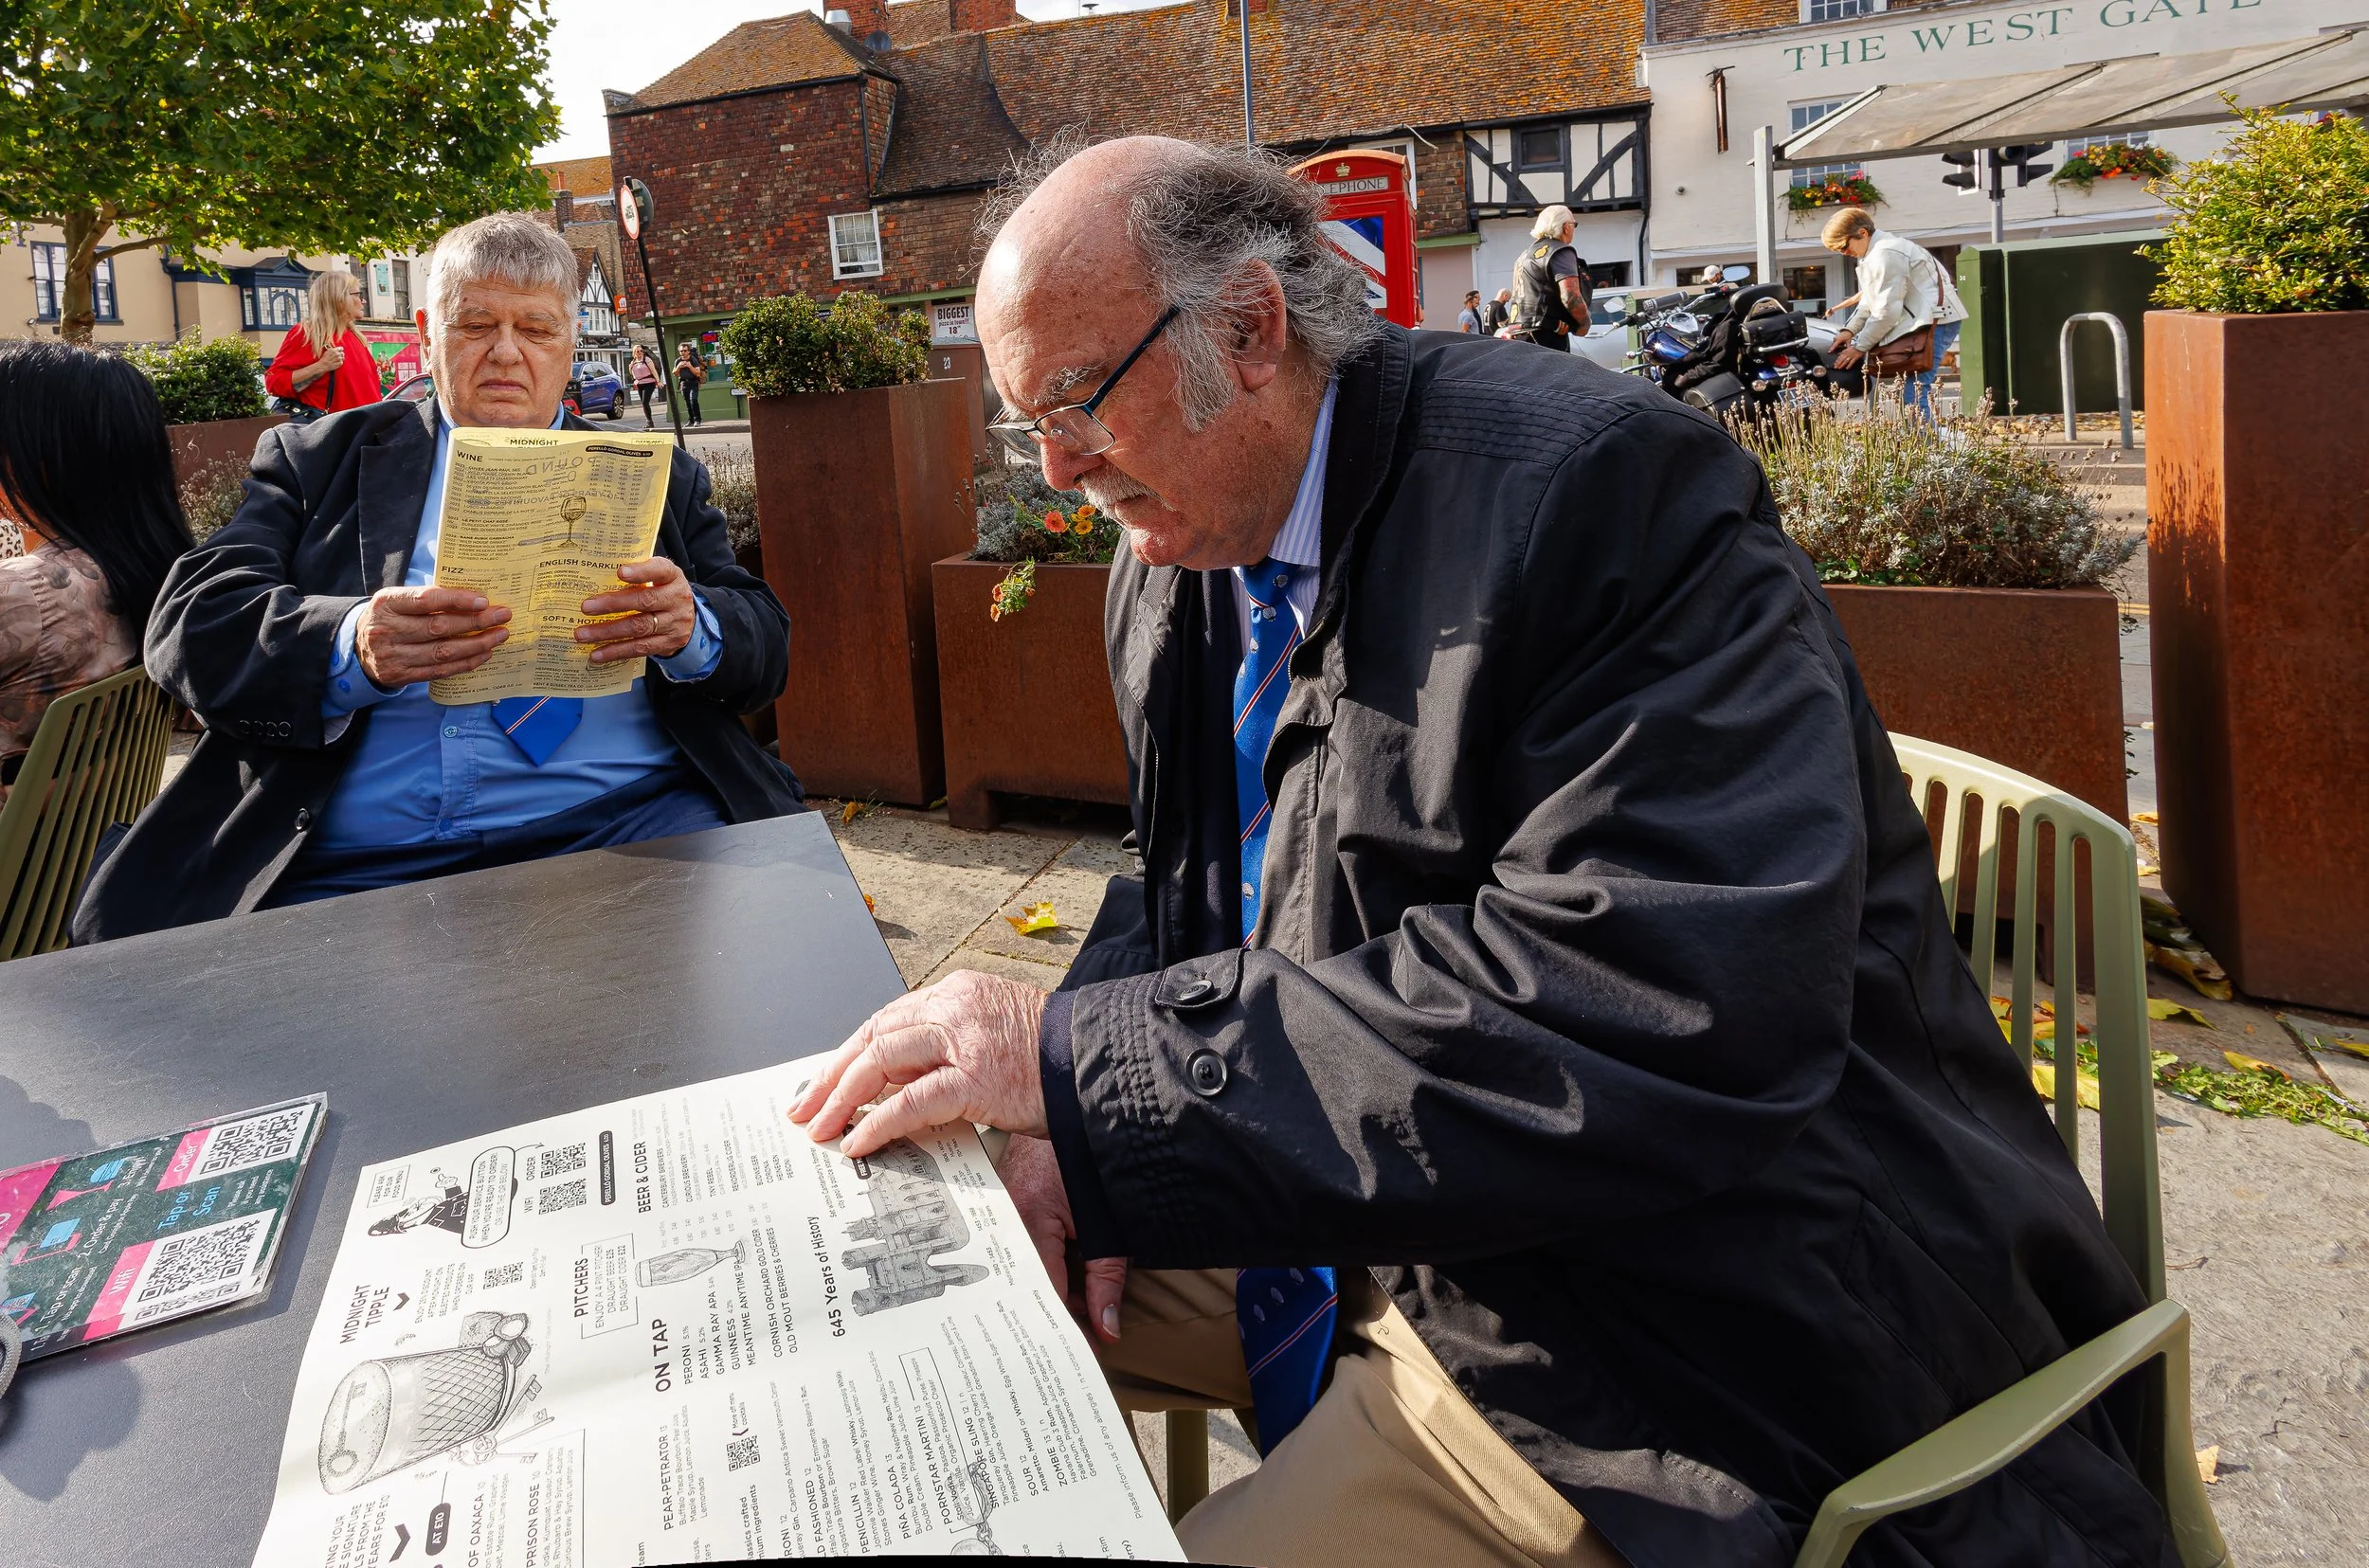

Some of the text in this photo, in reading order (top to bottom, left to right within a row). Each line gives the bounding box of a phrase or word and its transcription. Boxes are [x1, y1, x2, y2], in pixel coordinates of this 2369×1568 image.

[1782, 34, 1887, 72] THE
[1911, 8, 2073, 54] WEST
[938, 306, 969, 319] BIGGEST
[943, 356, 951, 369] 23
[457, 450, 483, 462] WINE
[539, 558, 579, 568] ENGLISH
[173, 1145, 197, 1172] Order
[477, 1161, 486, 1183] BUTTON
[526, 1156, 535, 1181] ORDER
[634, 1142, 648, 1174] CIDER
[858, 1163, 867, 1176] FREE
[657, 1148, 669, 1208] CANTERBURY BREWERS
[680, 1155, 693, 1202] CURIOUS BREWERY
[706, 1167, 714, 1184] REBEL
[192, 1186, 221, 1216] Scan
[226, 1189, 243, 1208] Please
[372, 1185, 383, 1202] PLEASE
[392, 1184, 401, 1199] FOOD
[474, 1184, 483, 1208] SERVICE
[524, 1197, 533, 1213] WIFI
[637, 1185, 651, 1213] BEER
[157, 1188, 195, 1230] Tap or
[83, 1222, 107, 1248] Order
[99, 1213, 113, 1222] &
[106, 1199, 123, 1214] pay
[469, 1225, 478, 1239] PUSH
[766, 1228, 780, 1257] CHERRIES
[63, 1265, 83, 1289] scan
[68, 1299, 80, 1310] app
[77, 1266, 98, 1292] download
[108, 1268, 136, 1295] Wifi
[574, 1258, 588, 1318] PITCHERS
[774, 1265, 787, 1299] BERRIES
[807, 1217, 845, 1337] 645 Years of History
[1003, 1266, 1015, 1286] Medieval
[51, 1287, 72, 1302] or
[365, 1287, 389, 1328] TIPPLE
[751, 1229, 783, 1358] CORNISH ORCHARD GOLD CIDER
[40, 1302, 63, 1323] Tap
[339, 1285, 371, 1344] MIDNIGHT
[782, 1302, 794, 1332] MOUT
[652, 1319, 671, 1392] ON TAP
[787, 1334, 798, 1353] OLD
[681, 1344, 693, 1384] PERONI
[698, 1348, 709, 1378] ASAHI
[848, 1379, 857, 1393] Juice
[852, 1394, 861, 1415] Lemon
[962, 1406, 969, 1415] 12
[915, 1415, 934, 1461] MARTINI
[965, 1417, 980, 1447] SLING
[1043, 1434, 1051, 1444] 13
[822, 1438, 830, 1459] Sugar
[854, 1448, 863, 1469] Label
[863, 1440, 873, 1464] Honey
[826, 1460, 836, 1486] Brown
[858, 1469, 867, 1487] Red
[974, 1448, 1000, 1510] SINGAPORE
[1020, 1454, 1039, 1496] SOUR 12
[1047, 1447, 1068, 1487] ZOMBIE
[697, 1477, 708, 1518] Lemonade
[805, 1468, 823, 1542] FASHIONED 12
[863, 1488, 874, 1516] Walker
[875, 1489, 885, 1516] Ginger
[882, 1452, 912, 1540] PIÑA COLADA 13
[929, 1463, 952, 1524] PORNSTAR
[373, 1510, 386, 1532] FOR
[739, 1497, 750, 1528] crafted
[750, 1485, 762, 1534] ingredients
[780, 1514, 787, 1523] 12
[849, 1482, 870, 1554] PENICILLIN 12
[331, 1516, 344, 1541] YOUR
[341, 1504, 362, 1559] SIGNATURE
[356, 1501, 375, 1551] FROM THE
[432, 1512, 444, 1543] AT £10
[870, 1517, 881, 1549] Johnnie
[880, 1518, 892, 1546] Stones
[1099, 1537, 1110, 1553] Rim
